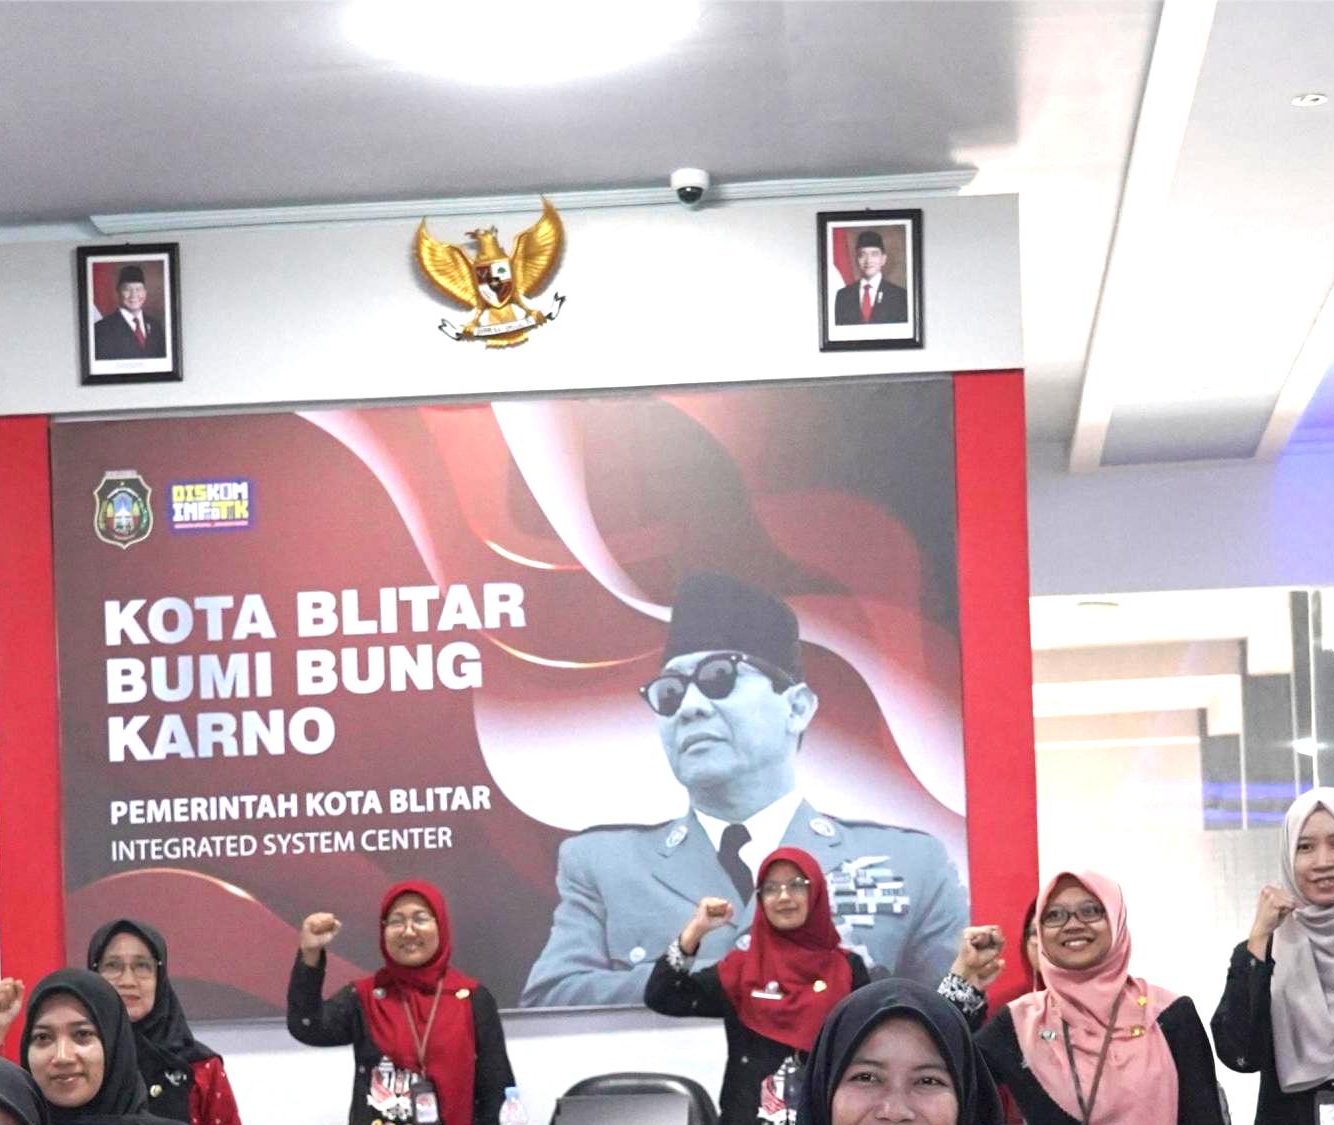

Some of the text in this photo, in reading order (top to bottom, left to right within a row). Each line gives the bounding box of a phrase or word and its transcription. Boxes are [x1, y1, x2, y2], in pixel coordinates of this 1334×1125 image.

[172, 482, 248, 502] DISKOM
[104, 582, 526, 646] KOTA BLITAR
[106, 641, 483, 704] BUMI BUNG
[107, 706, 336, 762] KARNO
[110, 785, 491, 824] PEMERINTAH KOTA BLITAR
[111, 827, 453, 861] INTEGRATED SYSTEM CENTER
